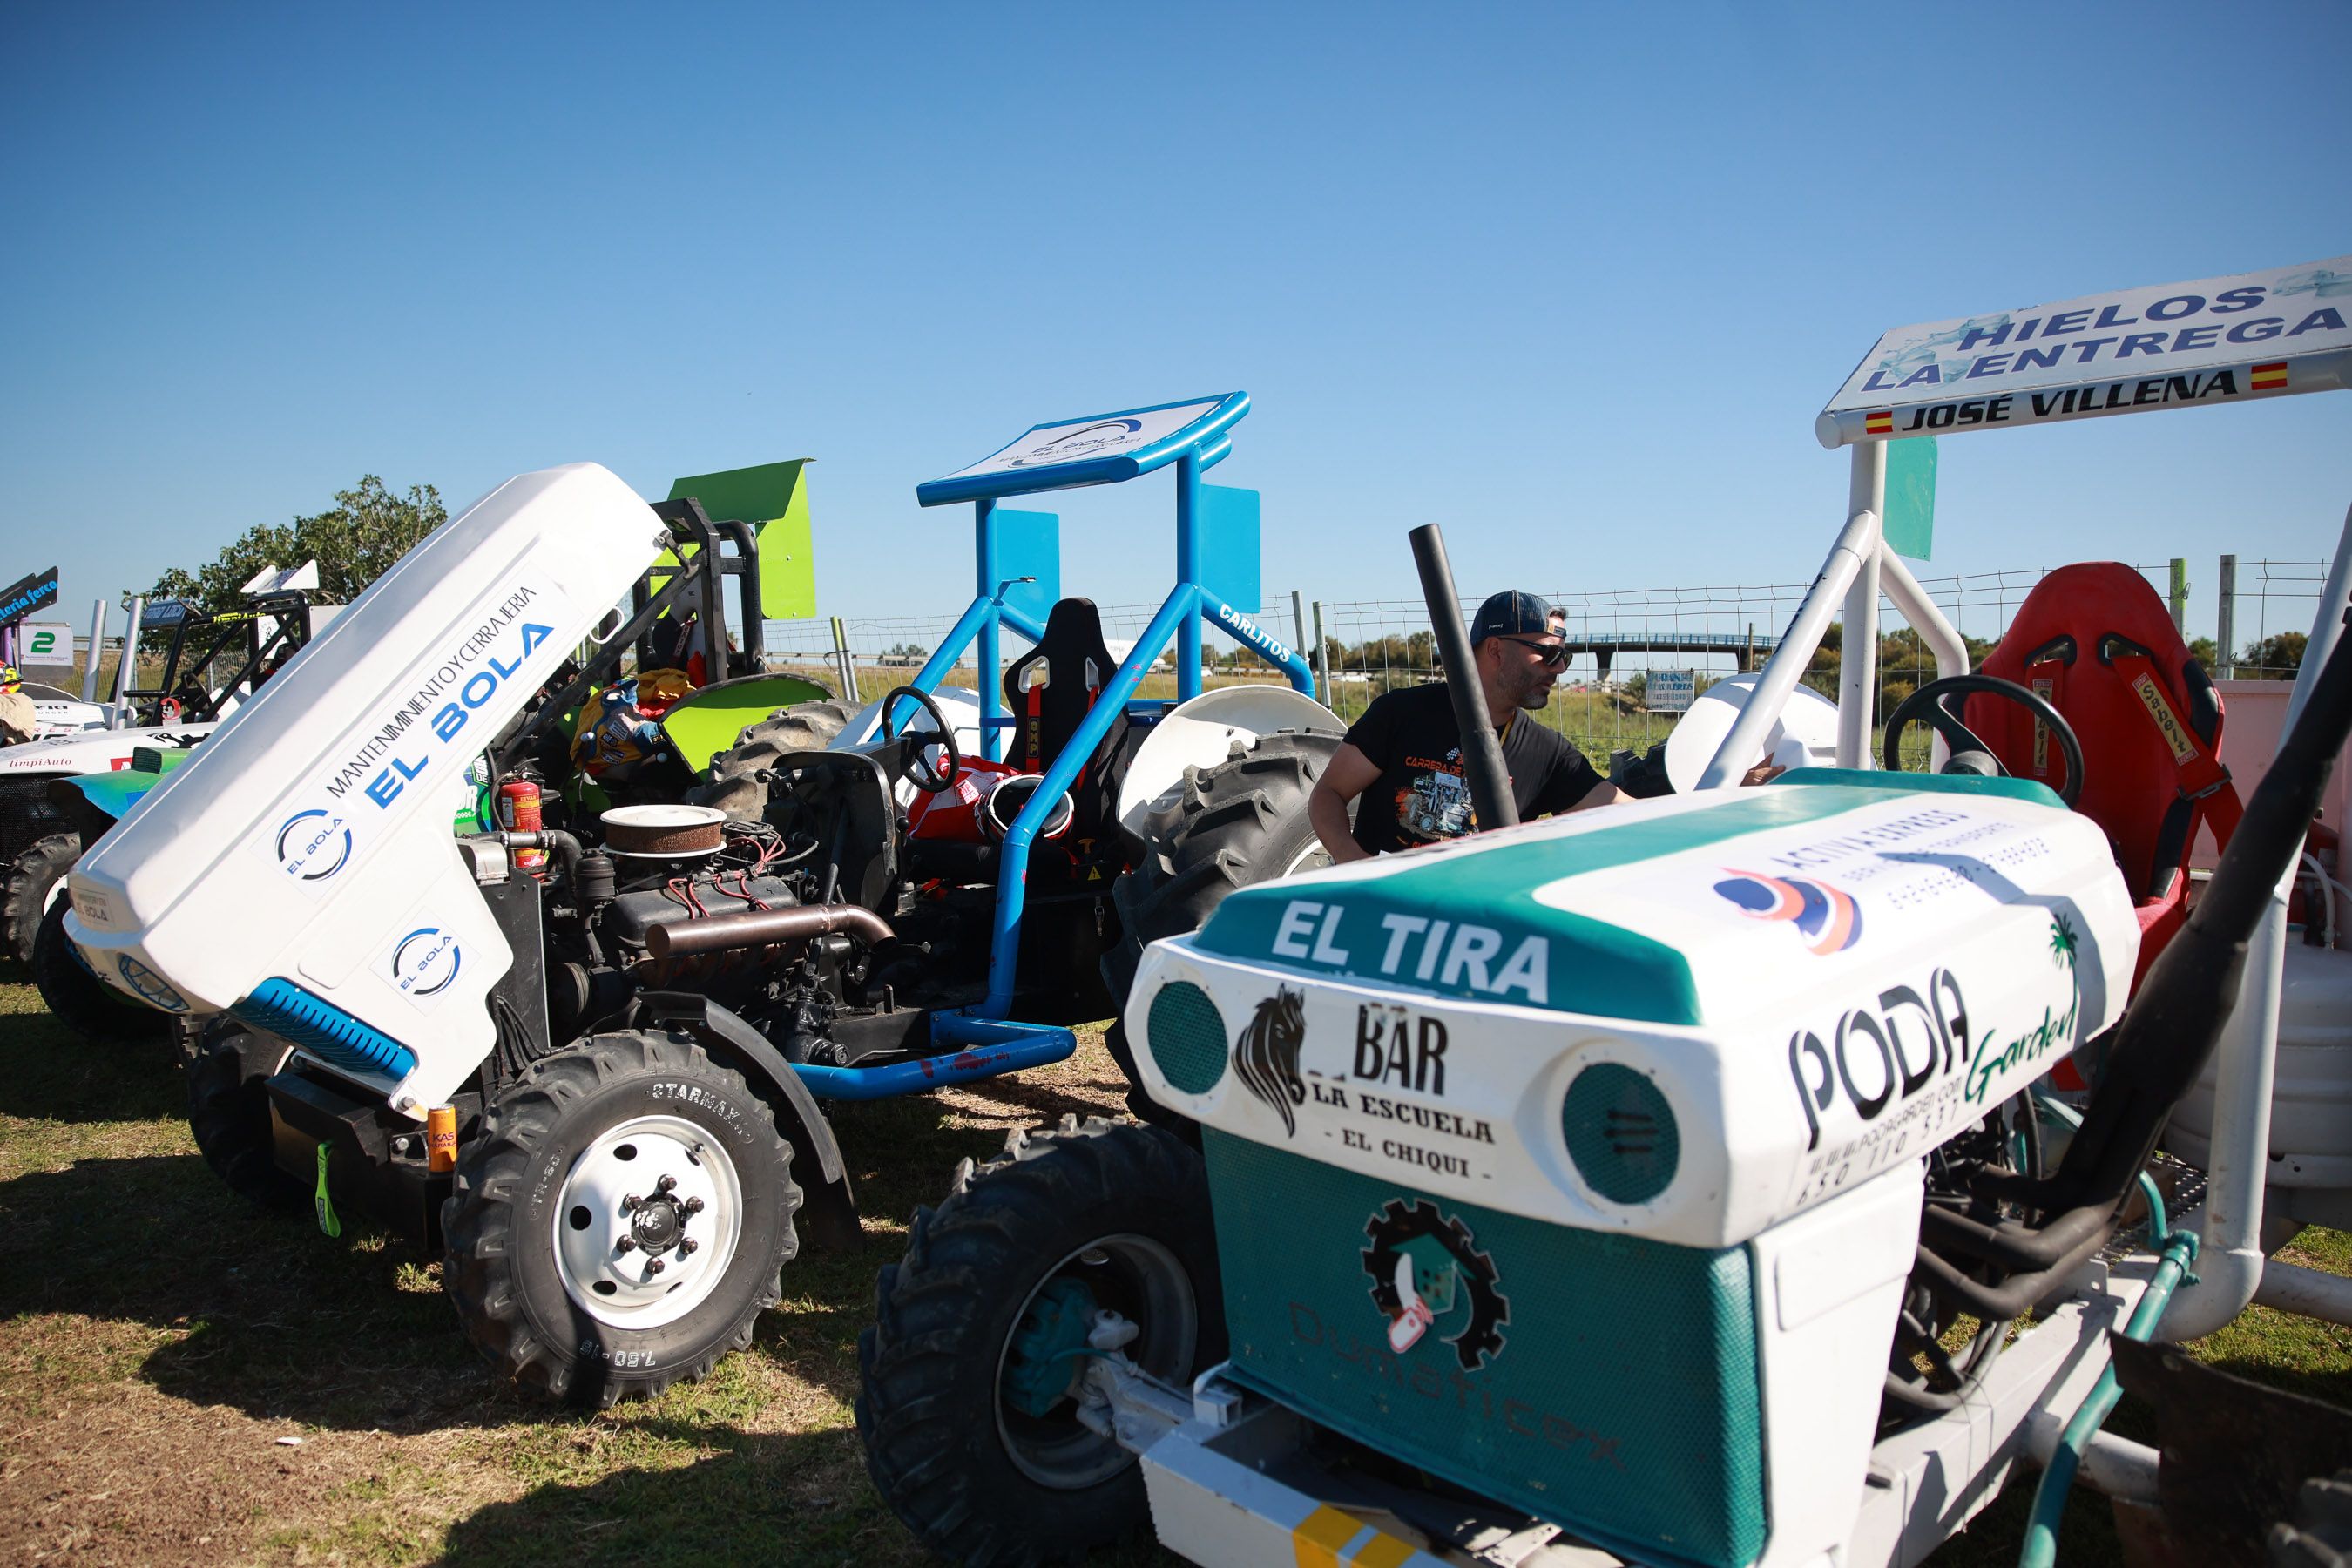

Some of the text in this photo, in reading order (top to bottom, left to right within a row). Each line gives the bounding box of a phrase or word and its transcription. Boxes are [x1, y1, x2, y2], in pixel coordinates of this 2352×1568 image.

[1957, 286, 2267, 351] HIELOS
[1861, 308, 2348, 393] LA ENTREGA
[1902, 370, 2239, 431] JOSÉ VILLENA
[26, 580, 57, 605] ferco
[459, 586, 537, 662] CERRAJERIA
[30, 632, 56, 653] 2
[1220, 603, 1292, 663] CARLITOS
[364, 623, 555, 810] EL BOLA
[2143, 684, 2186, 753] Sabelt
[287, 818, 344, 875] EL BOLA
[401, 935, 453, 990] EL BOLA
[1272, 900, 1550, 1004] EL TIRA
[1353, 1004, 1449, 1096] BAR
[1788, 966, 1970, 1152] PODA
[1965, 1004, 2078, 1105] Garden
[432, 1131, 454, 1143] KAS
[1312, 1083, 1495, 1145] LA ESCUELA
[1342, 1129, 1470, 1179] EL CHIQUI
